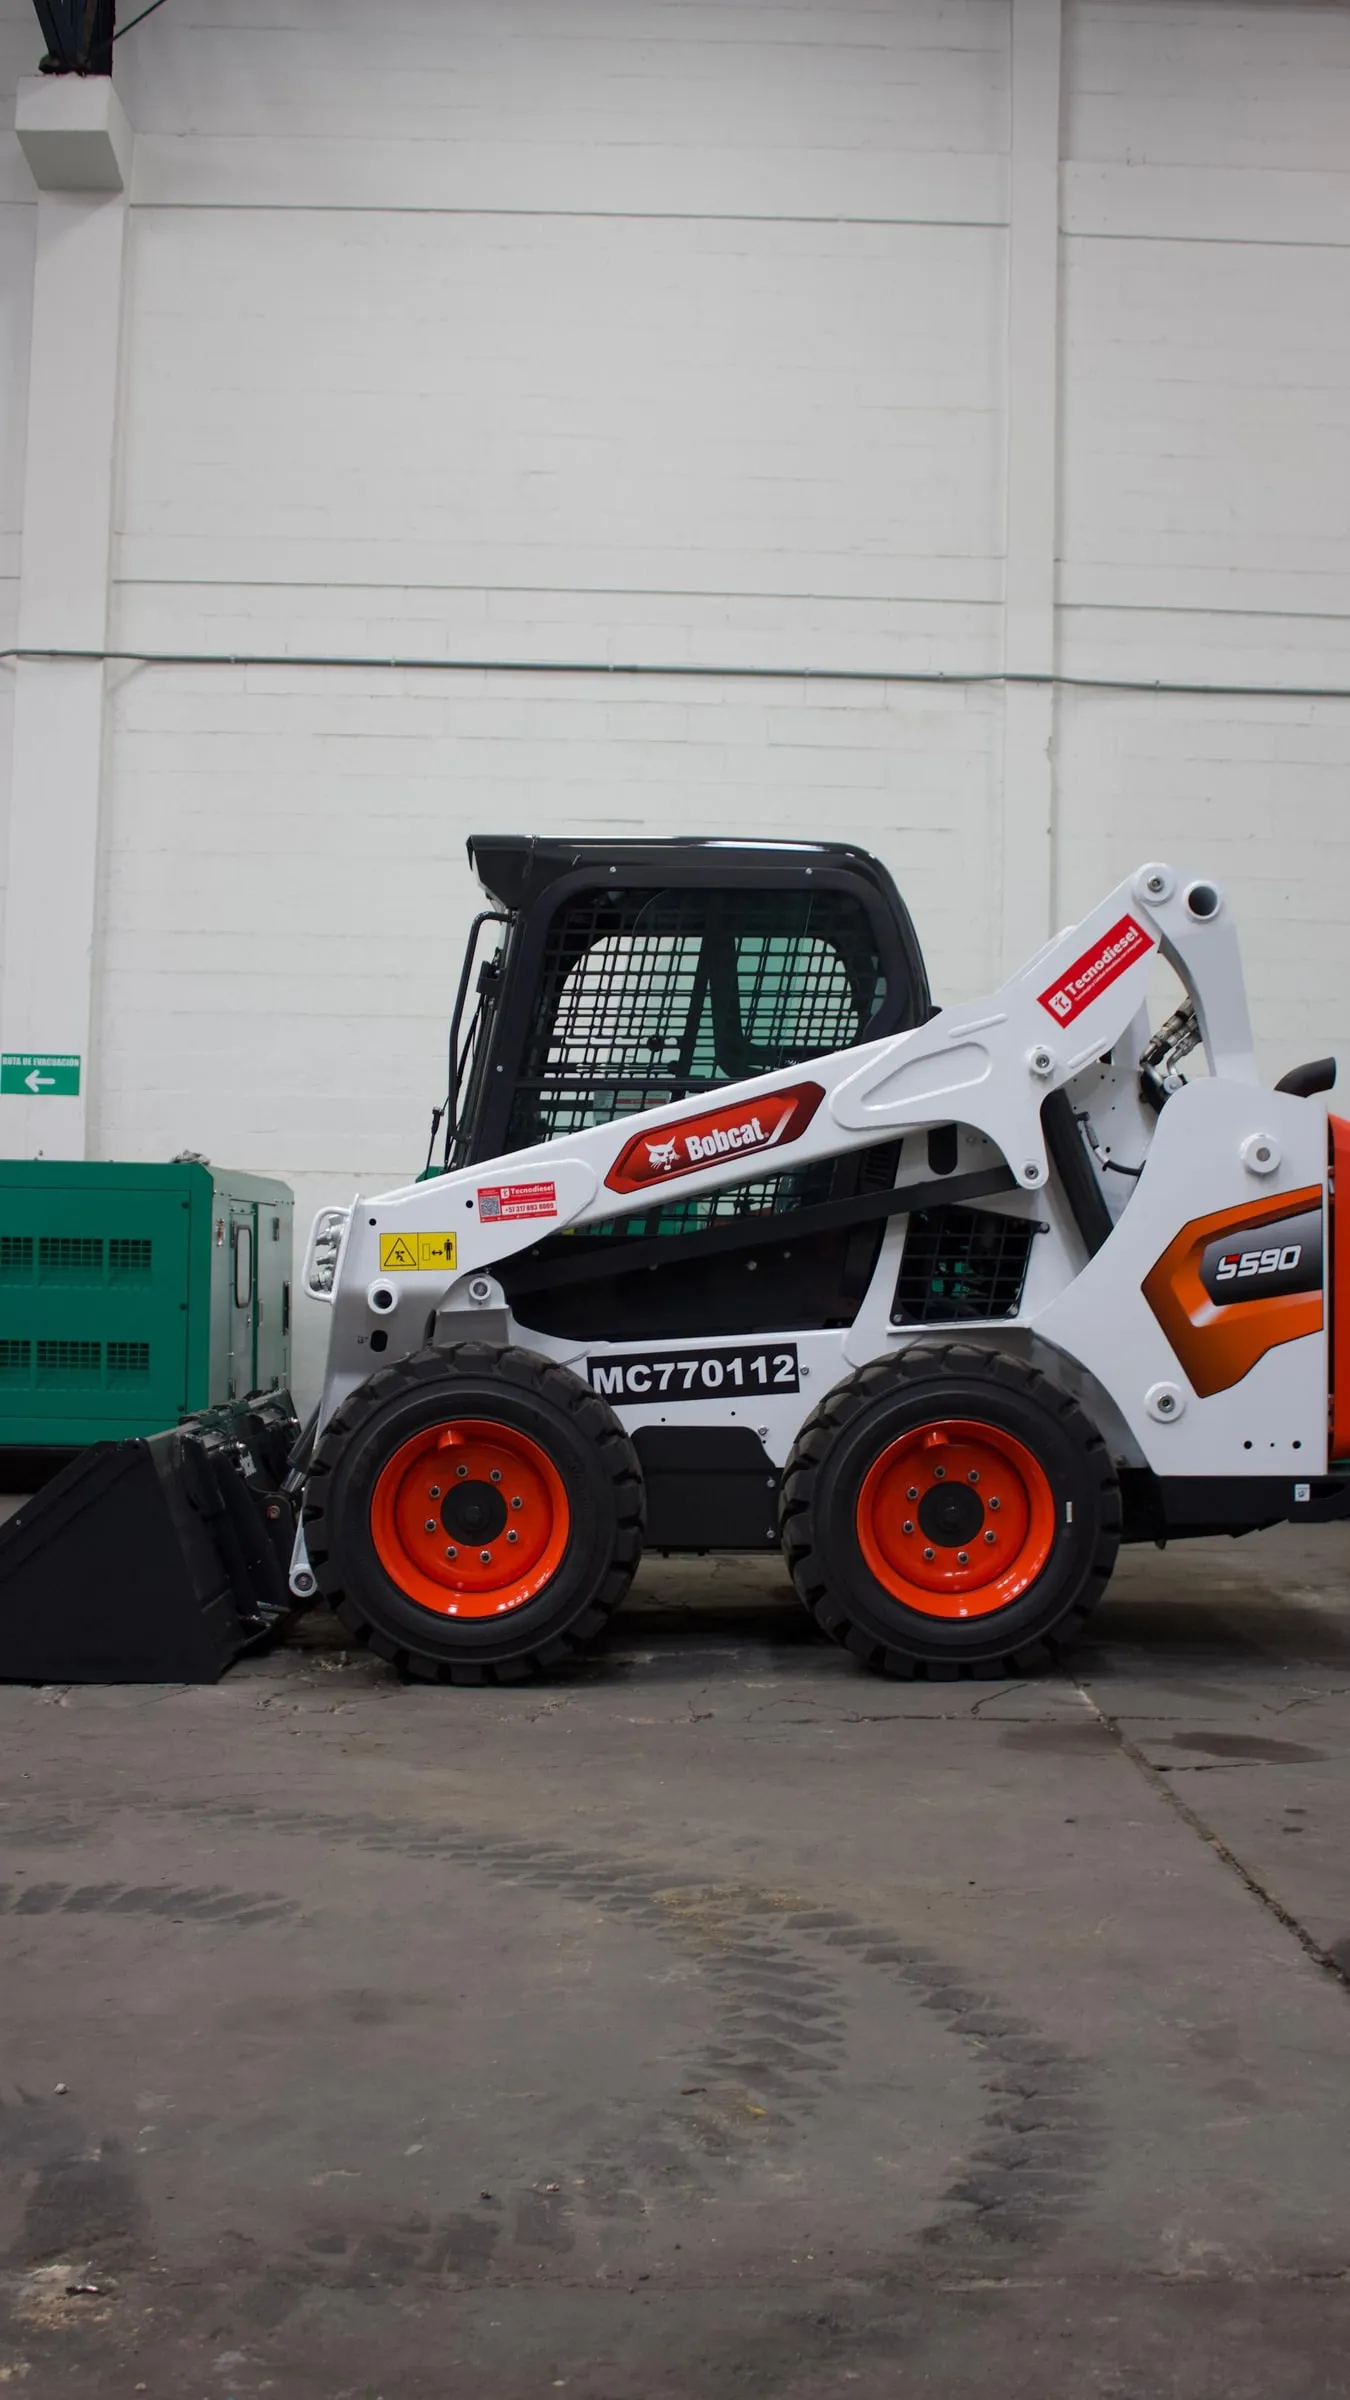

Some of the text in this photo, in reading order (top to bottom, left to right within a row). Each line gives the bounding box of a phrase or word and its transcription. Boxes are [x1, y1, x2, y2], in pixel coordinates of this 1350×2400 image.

[1064, 925, 1139, 995] Tecnodiesel
[2, 1056, 21, 1066] RUTA
[22, 1056, 32, 1066] DE
[685, 1117, 765, 1162] Bobcat
[511, 1184, 554, 1194] Tecnodiesel
[1216, 1245, 1302, 1280] S590
[592, 1354, 796, 1395] MC770112
